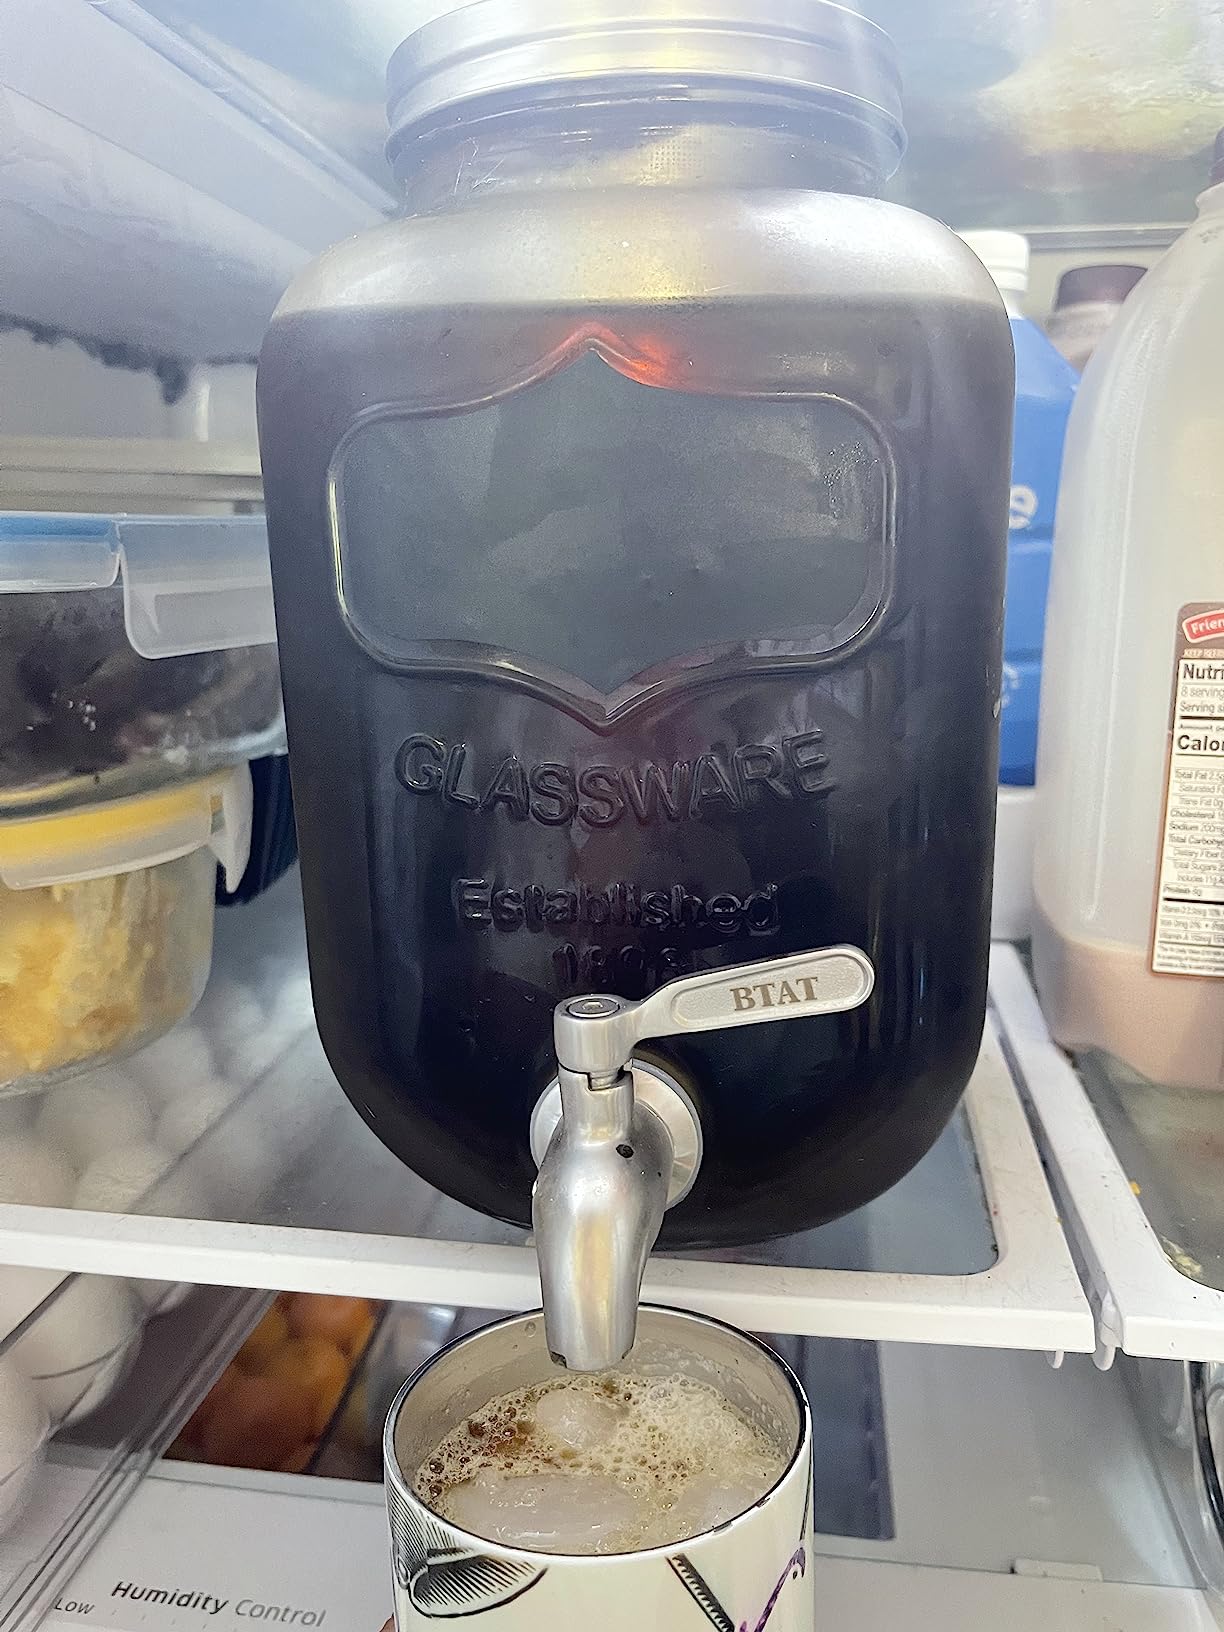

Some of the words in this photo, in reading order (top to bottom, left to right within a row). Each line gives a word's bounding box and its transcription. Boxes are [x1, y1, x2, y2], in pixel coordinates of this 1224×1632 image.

[395, 728, 836, 829] GLASSWARE
[454, 876, 781, 937] Established
[729, 975, 819, 1012] BTAT
[111, 1581, 229, 1615] Humidity
[235, 1599, 327, 1628] Control
